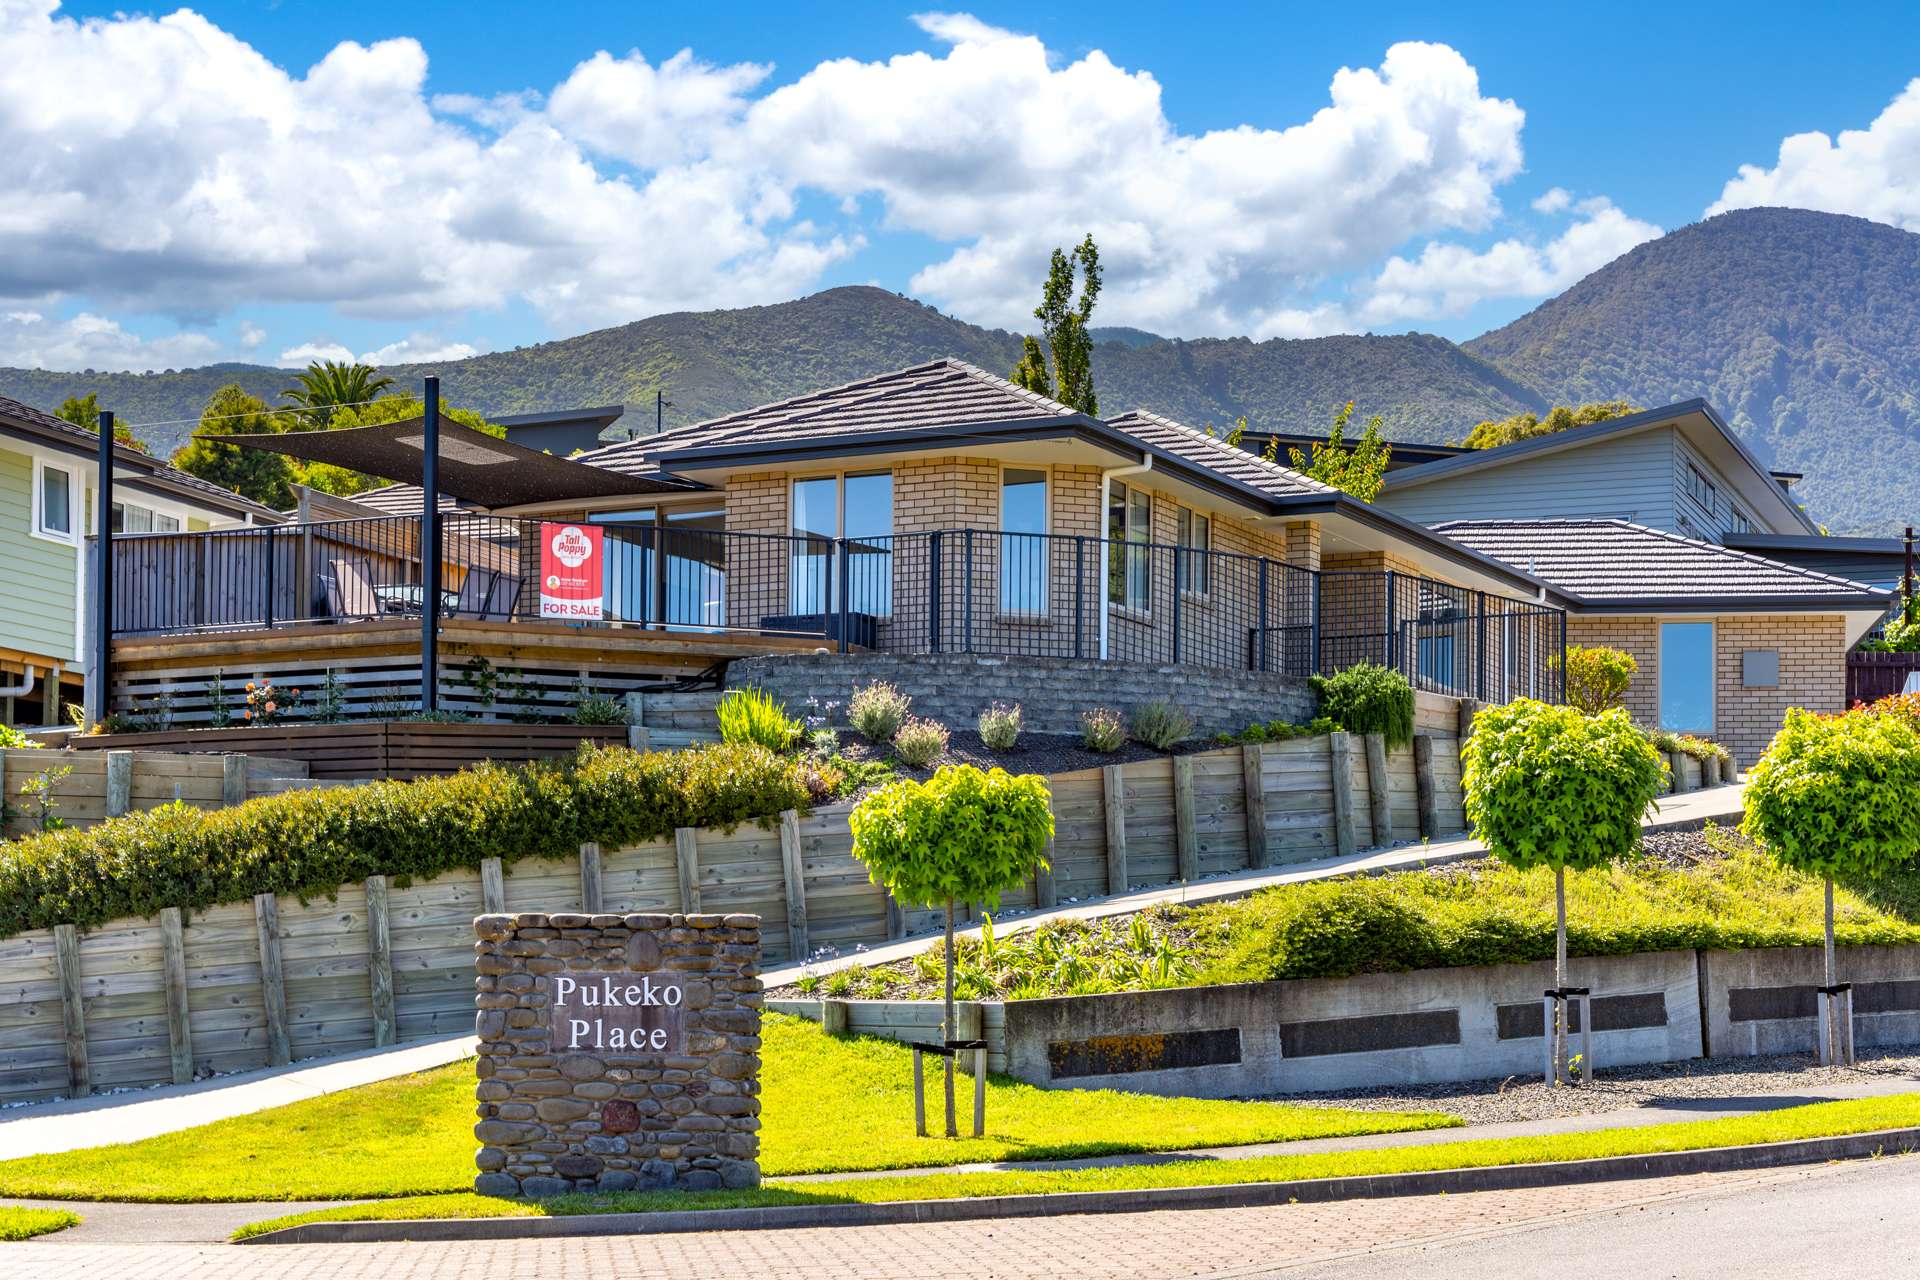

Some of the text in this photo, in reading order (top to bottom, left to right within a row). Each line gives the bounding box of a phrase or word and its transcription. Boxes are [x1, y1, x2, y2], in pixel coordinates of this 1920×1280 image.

[565, 534, 580, 544] Tall
[558, 542, 586, 555] Poppy
[543, 603, 600, 616] FOR SALE
[553, 976, 682, 1006] Pukeko
[567, 1018, 668, 1050] Place
